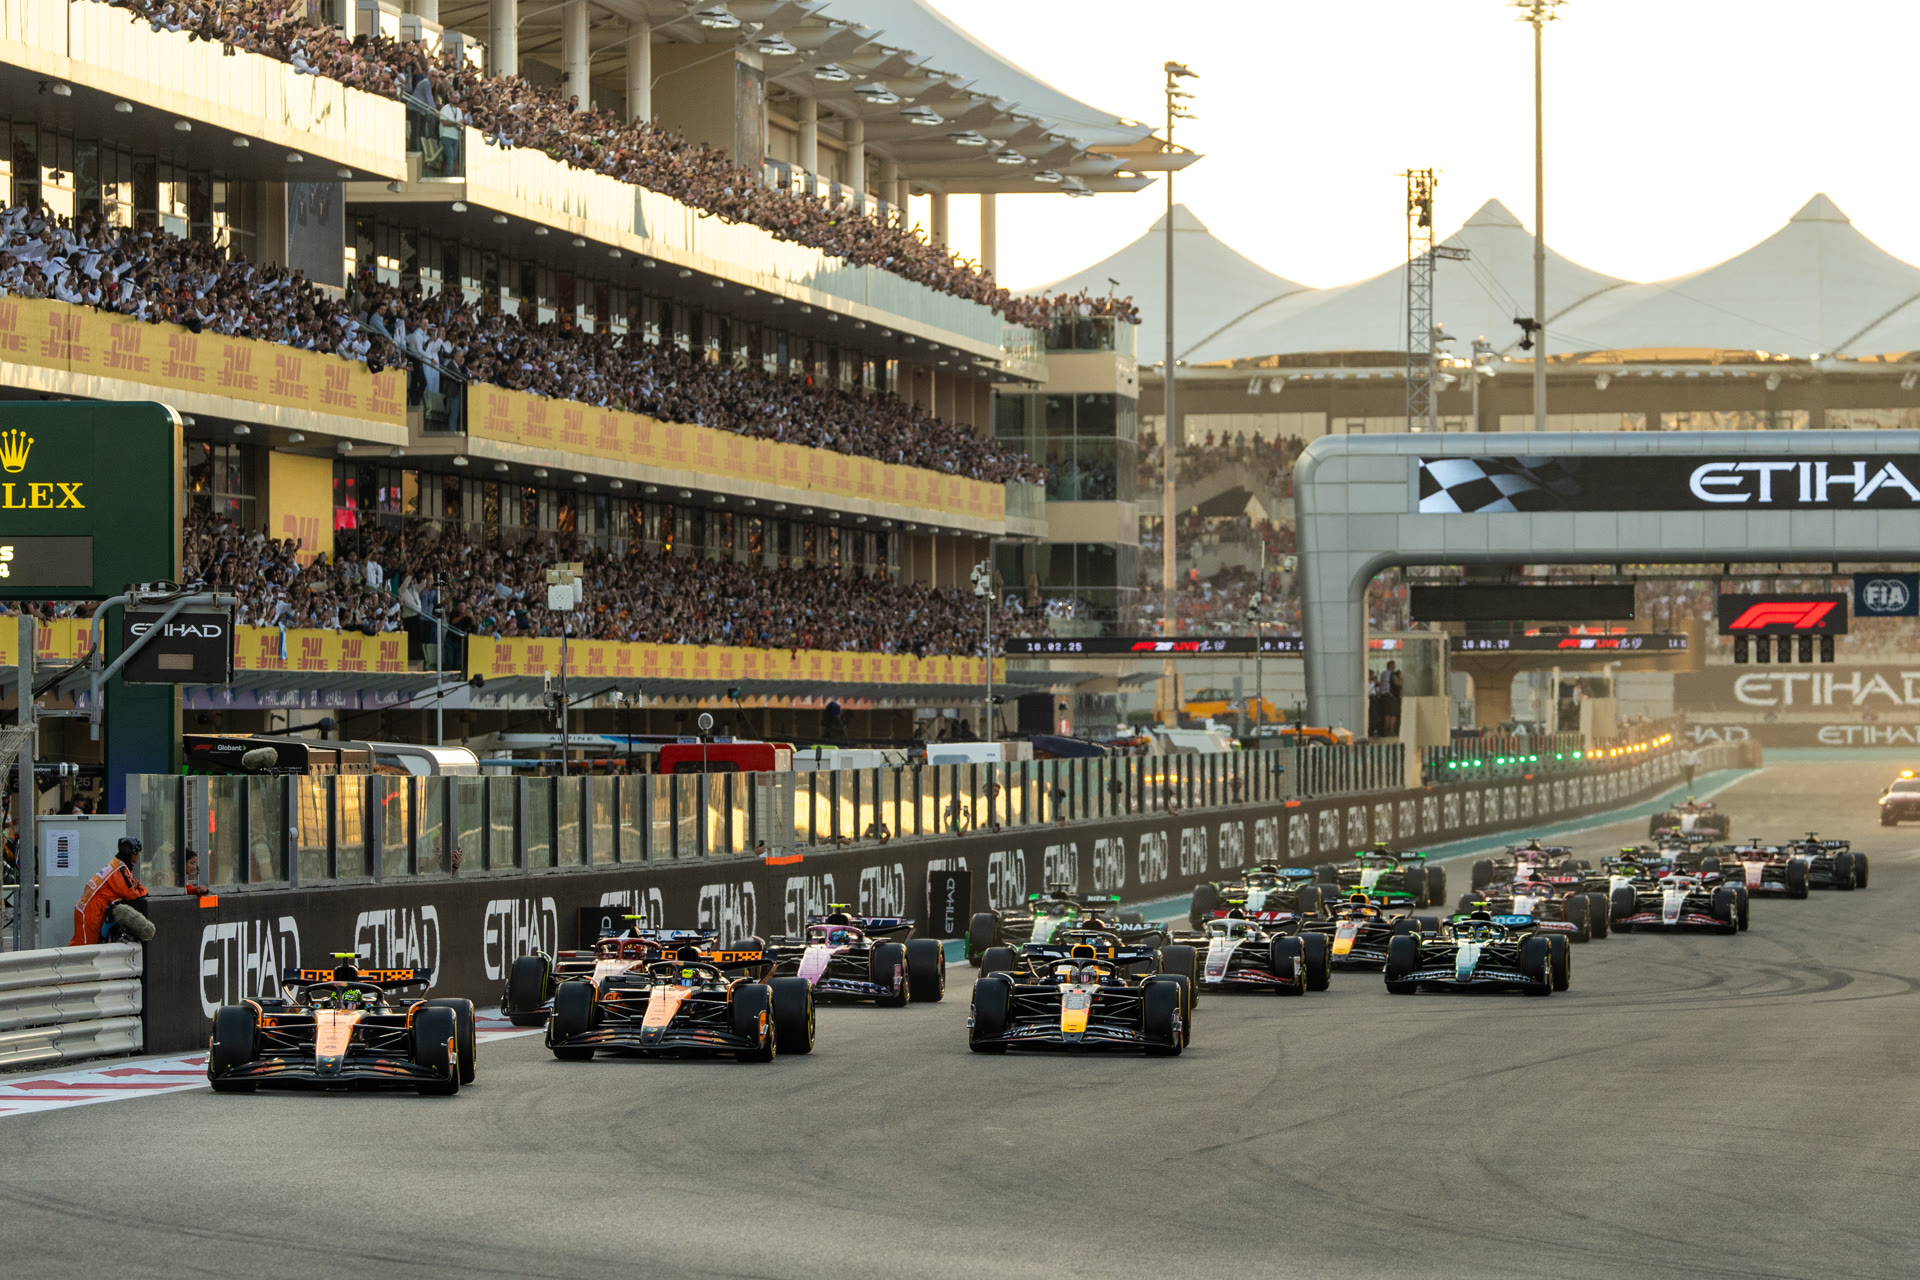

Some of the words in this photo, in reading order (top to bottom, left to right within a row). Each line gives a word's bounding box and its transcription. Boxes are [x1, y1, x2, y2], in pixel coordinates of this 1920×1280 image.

[1688, 461, 1920, 503] ETIHA
[1865, 584, 1906, 607] FIA
[217, 744, 243, 752] Globant
[1817, 725, 1920, 744] ETIHA
[945, 877, 956, 934] ETIHAD
[353, 905, 441, 995] ETIHAD
[483, 897, 559, 980] ETIHAD
[200, 915, 301, 1019] ETIHAD
